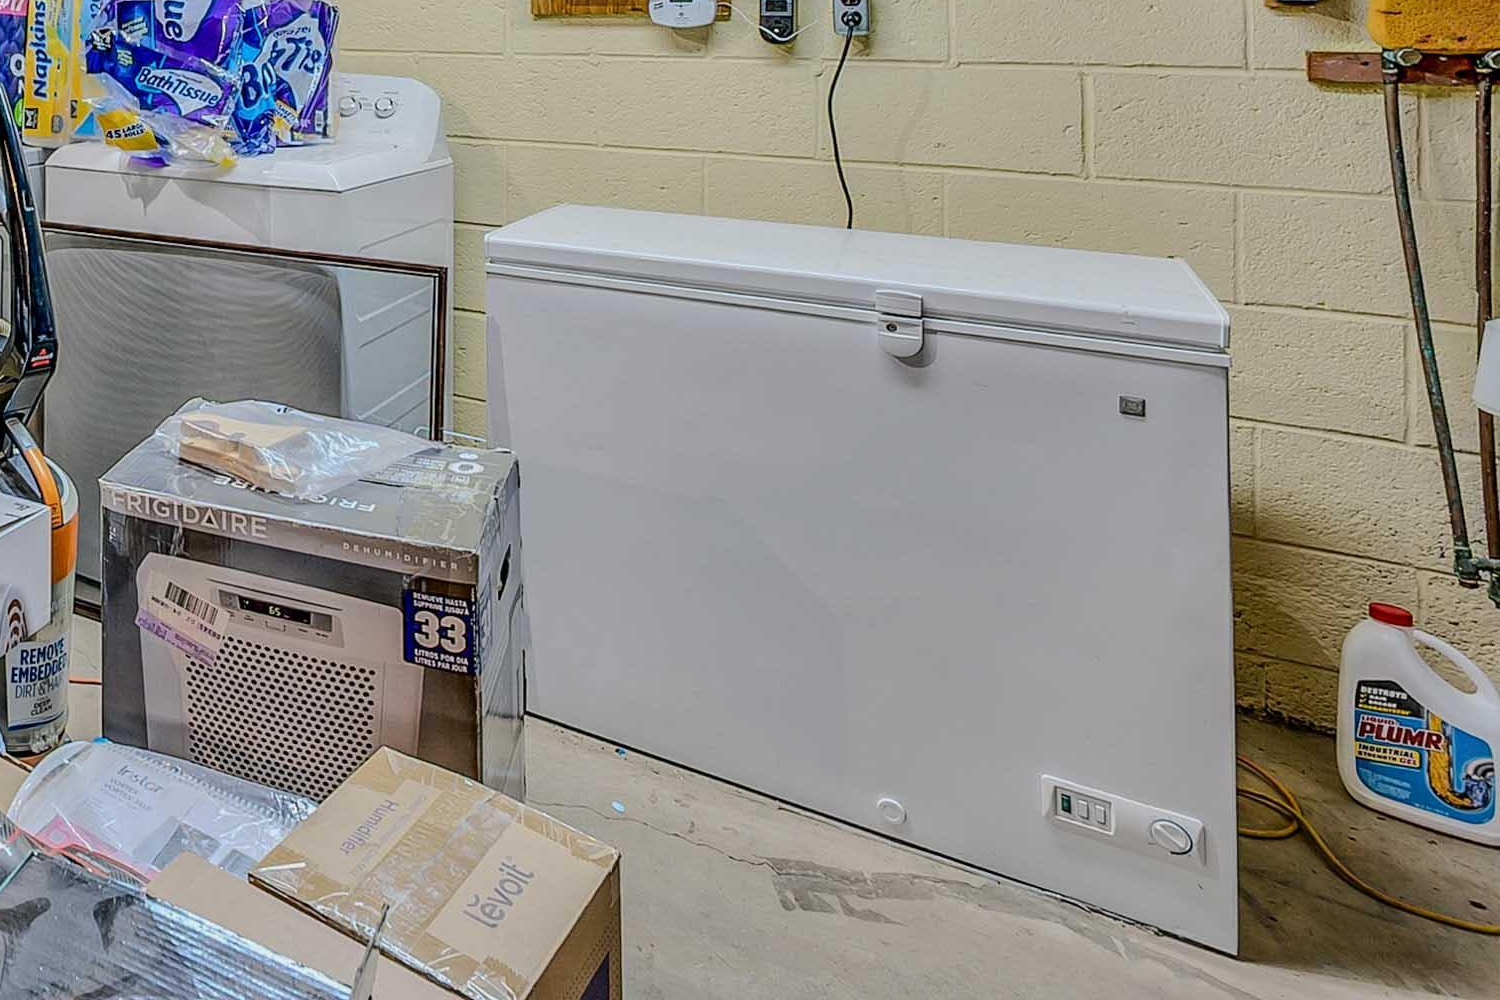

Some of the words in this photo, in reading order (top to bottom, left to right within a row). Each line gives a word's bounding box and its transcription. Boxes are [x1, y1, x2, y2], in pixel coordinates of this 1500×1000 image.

[33, 0, 53, 98] Napkins
[139, 67, 173, 91] Bath
[172, 78, 220, 105] Tissue
[106, 129, 122, 139] 45
[111, 491, 269, 539] FRIGIDAIRE
[342, 541, 460, 572] DEHUMIDIFIER
[414, 610, 467, 654] 33
[20, 637, 65, 666] REMOVE
[15, 681, 37, 699] DIRT
[37, 681, 46, 696] &
[1358, 744, 1413, 758] INDUSTRIAL
[340, 799, 399, 857] Humidifier
